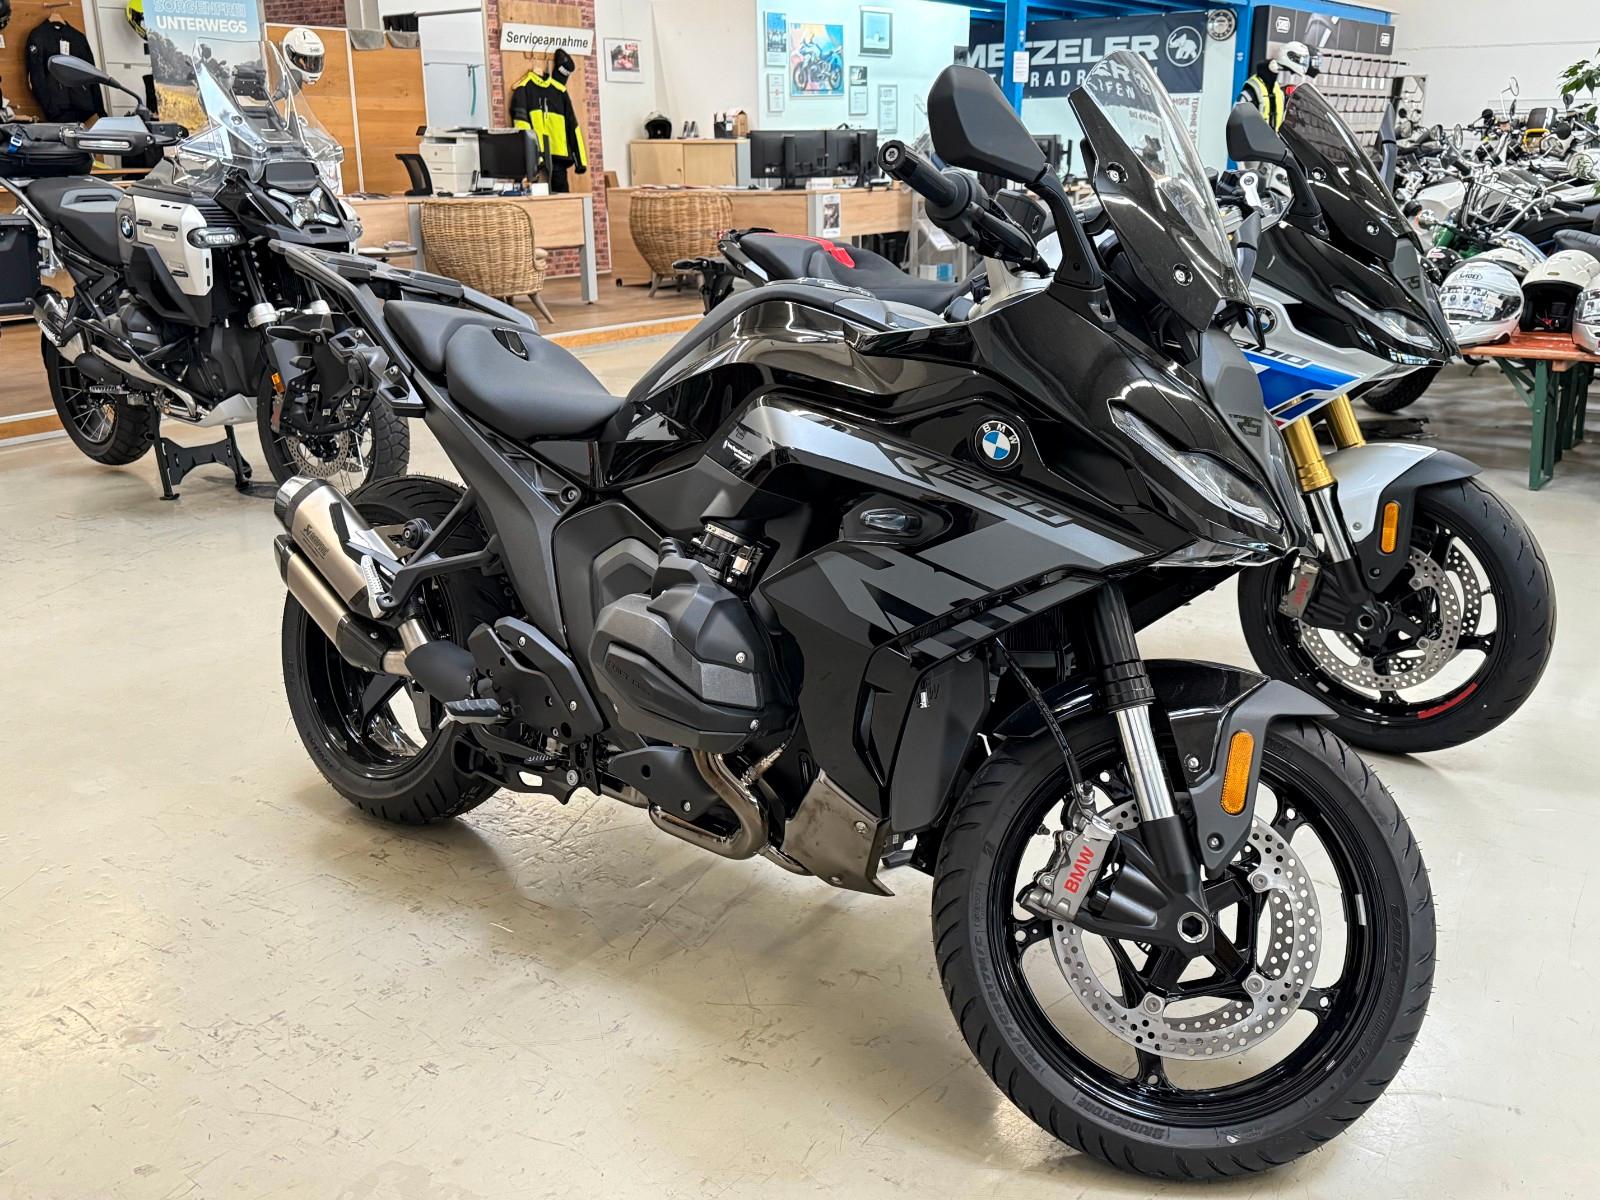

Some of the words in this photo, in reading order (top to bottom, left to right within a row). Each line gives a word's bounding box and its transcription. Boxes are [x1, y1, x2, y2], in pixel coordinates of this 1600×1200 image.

[155, 15, 248, 34] UNTERWEGS
[506, 31, 589, 49] Serviceannahme
[967, 34, 1160, 69] MEZELER
[982, 423, 1019, 445] BMW
[1064, 845, 1095, 894] BMW
[1076, 1096, 1166, 1140] BRIDGESTONE
